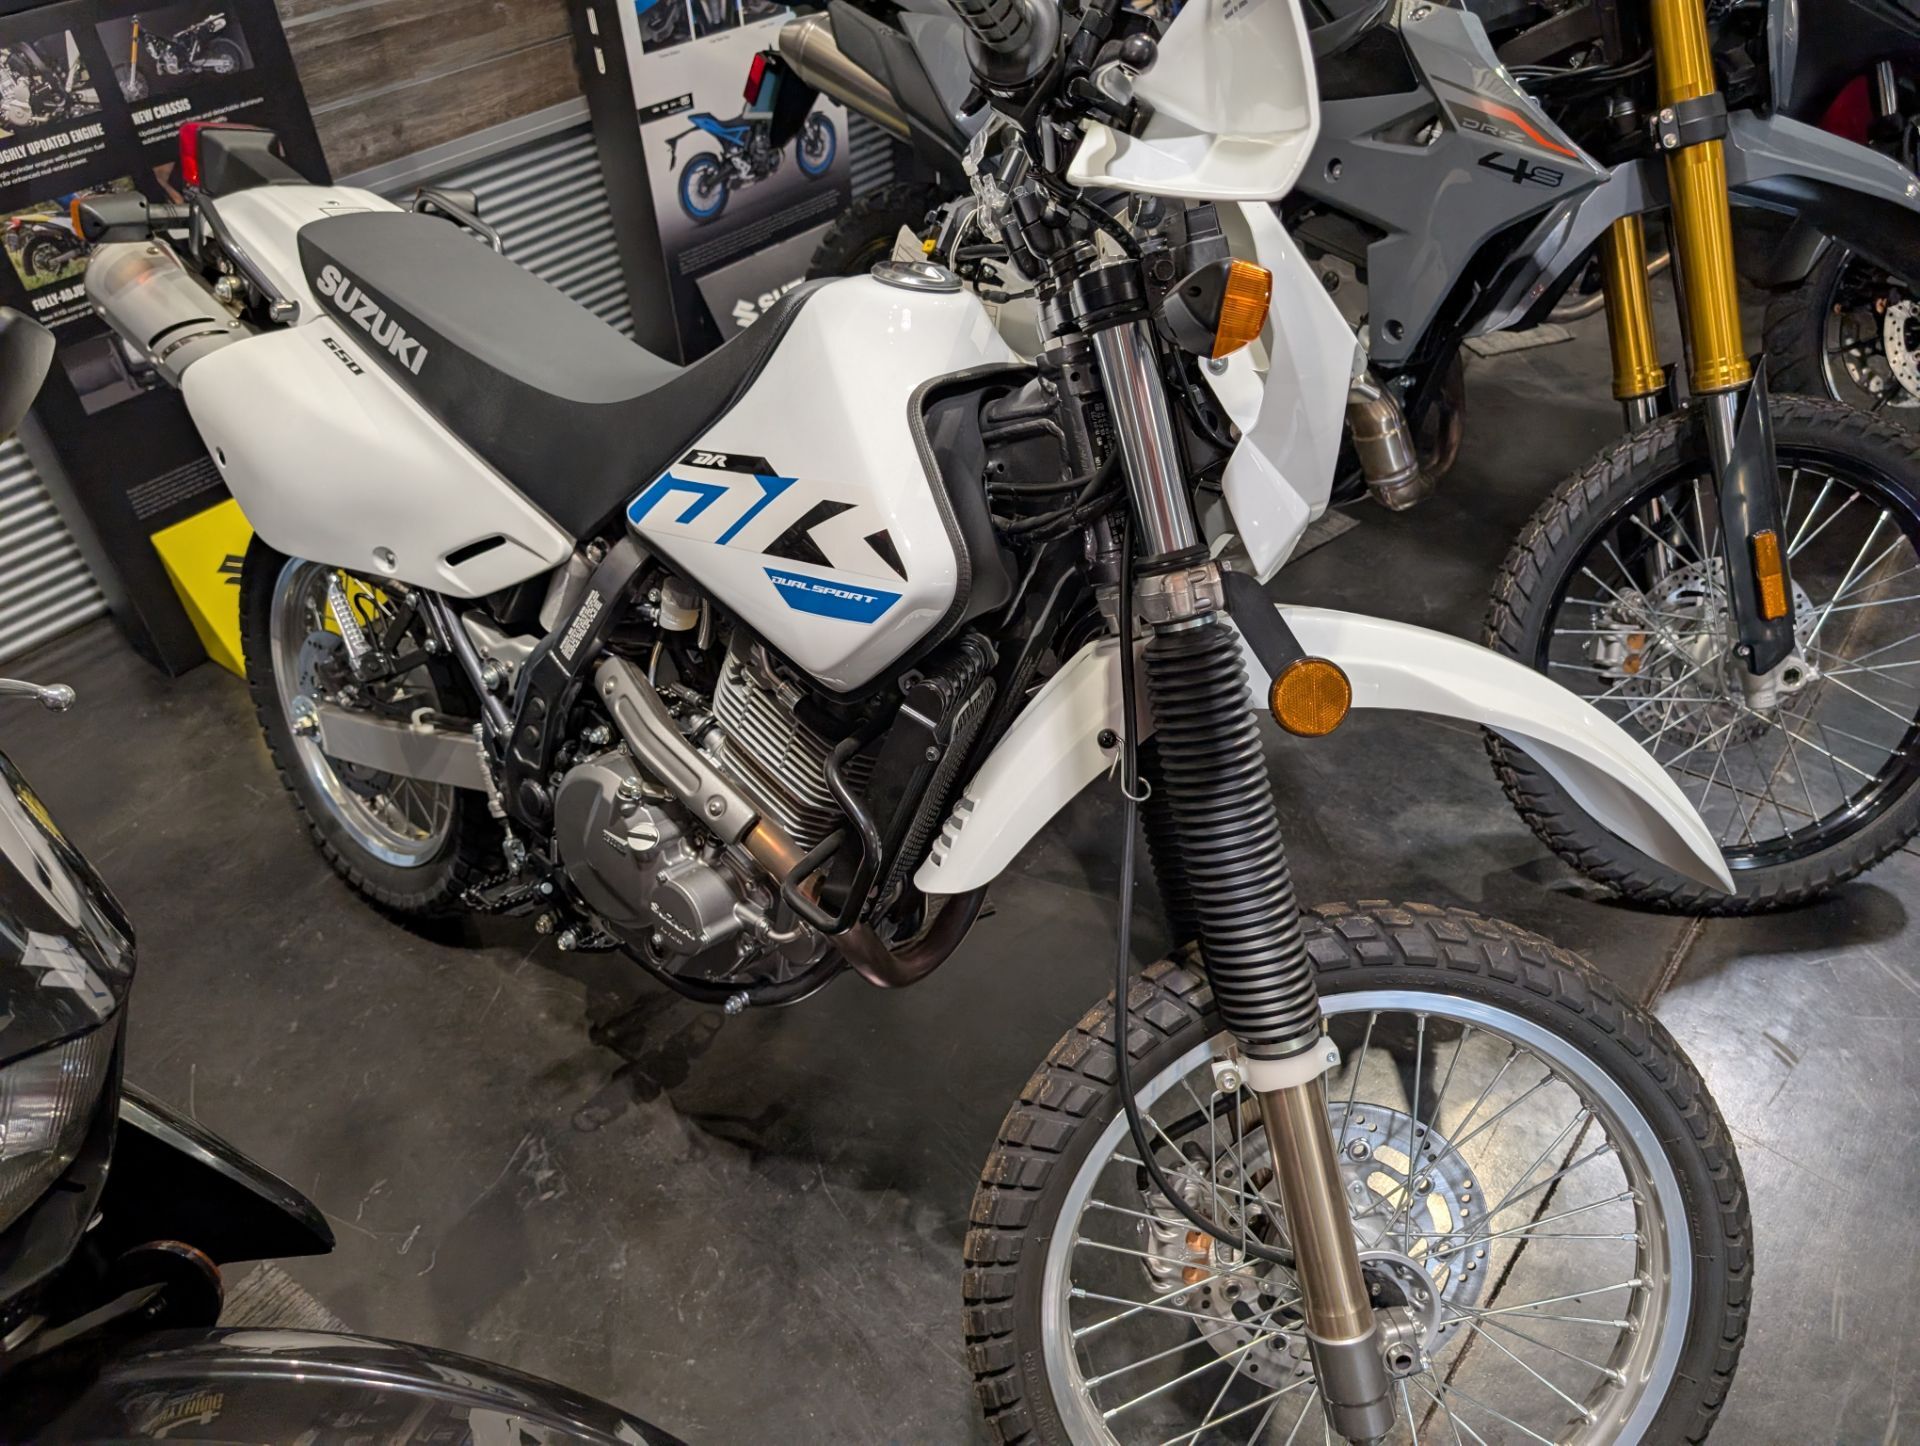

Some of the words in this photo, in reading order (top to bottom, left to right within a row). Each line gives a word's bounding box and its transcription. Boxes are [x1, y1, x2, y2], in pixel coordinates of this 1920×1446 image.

[131, 108, 154, 125] NEW
[152, 98, 192, 119] CHASSIS
[27, 133, 71, 155] UPDATED
[69, 123, 105, 143] ENGINE
[1461, 117, 1526, 144] DR-Z
[316, 264, 429, 376] SUZUKI
[321, 337, 366, 376] 650
[691, 452, 728, 468] DR
[811, 584, 879, 604] SPORT
